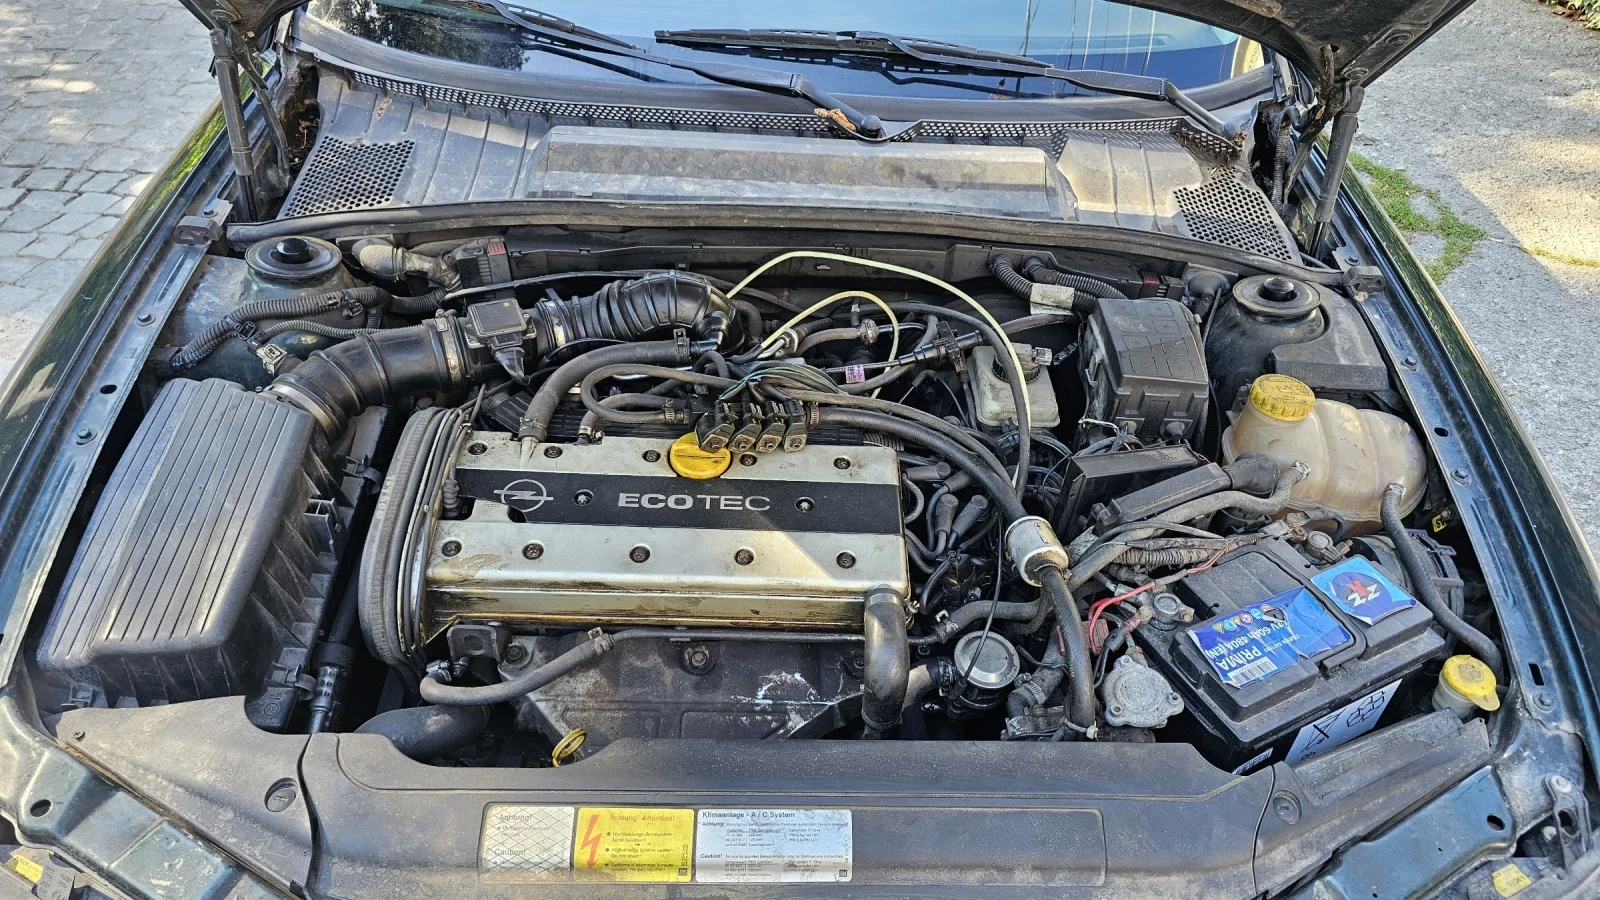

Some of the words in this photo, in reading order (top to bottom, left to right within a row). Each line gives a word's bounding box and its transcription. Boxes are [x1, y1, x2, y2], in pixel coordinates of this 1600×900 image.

[618, 492, 771, 511] ECOTEC
[1205, 642, 1227, 659] (EN)
[1224, 635, 1249, 653] 480A
[1215, 645, 1263, 671] PRIMA
[499, 814, 532, 822] Achtung!
[641, 814, 675, 822] Attention!
[701, 811, 744, 820] Klimaanlage
[769, 811, 795, 820] System
[494, 848, 527, 857] Caution!
